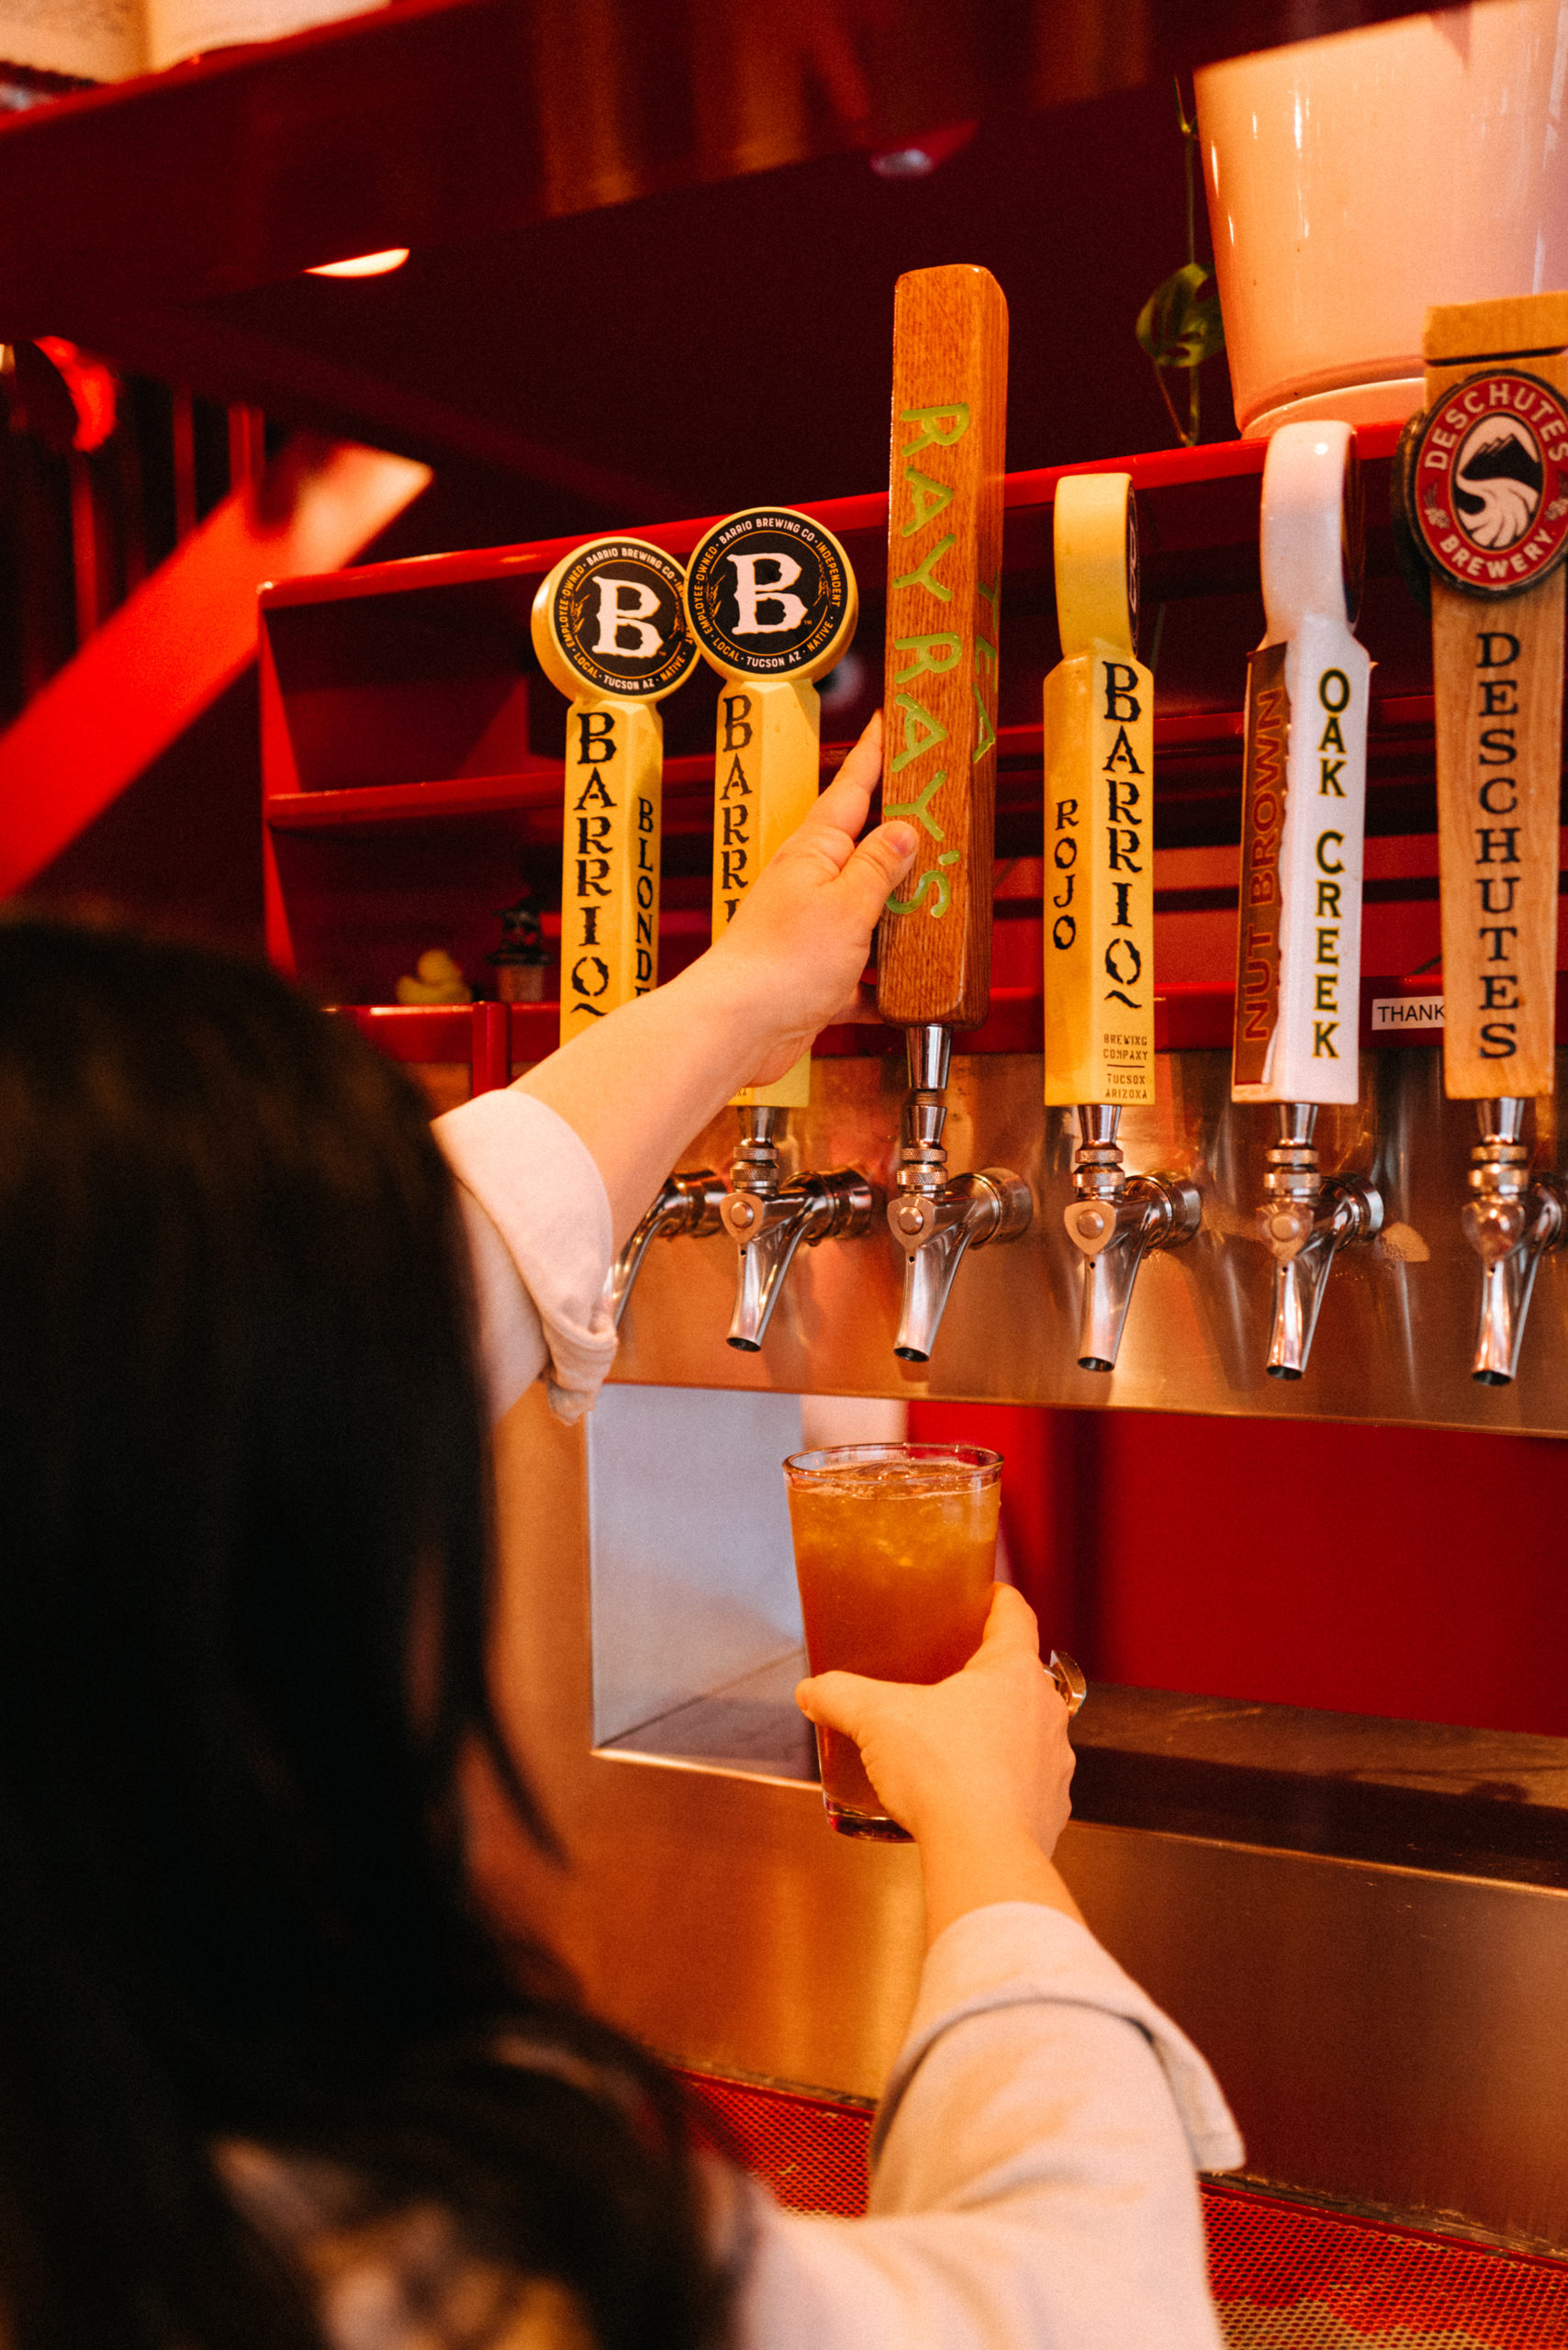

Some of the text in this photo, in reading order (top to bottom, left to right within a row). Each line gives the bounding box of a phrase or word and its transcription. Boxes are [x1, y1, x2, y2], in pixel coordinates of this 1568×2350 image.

[1425, 384, 1568, 470] DESCHUTES
[891, 402, 969, 602] RAY
[719, 518, 815, 544] BARRIO BREWING CO
[587, 547, 675, 579] BARRIO BREWING CO
[1439, 529, 1553, 578] BREWERY
[727, 553, 808, 635] B
[816, 542, 841, 608] INDEPENDENT
[591, 576, 664, 659] B
[807, 621, 834, 652] NATIVE
[574, 652, 598, 677] LOCAL
[660, 655, 685, 681] NATIVE
[712, 637, 739, 661] LOCAL
[746, 652, 801, 668] TUCSON AZ
[604, 674, 655, 690] TUCSON AZ
[720, 694, 753, 923] BARR
[1102, 661, 1145, 1009] BARRIO
[1474, 632, 1521, 1059] DESCHUTES
[570, 711, 617, 1016] BARRIO
[1053, 799, 1080, 950] ROJO
[1244, 687, 1285, 1042] NUT BROWN
[1311, 668, 1351, 1059] OAK CREEK
[1377, 1004, 1445, 1023] THANK
[1103, 1034, 1147, 1046] BREWING
[1103, 1048, 1148, 1060] COMPANY
[1105, 1089, 1148, 1099] ARIZONA
[1107, 1074, 1145, 1084] TUCSON
